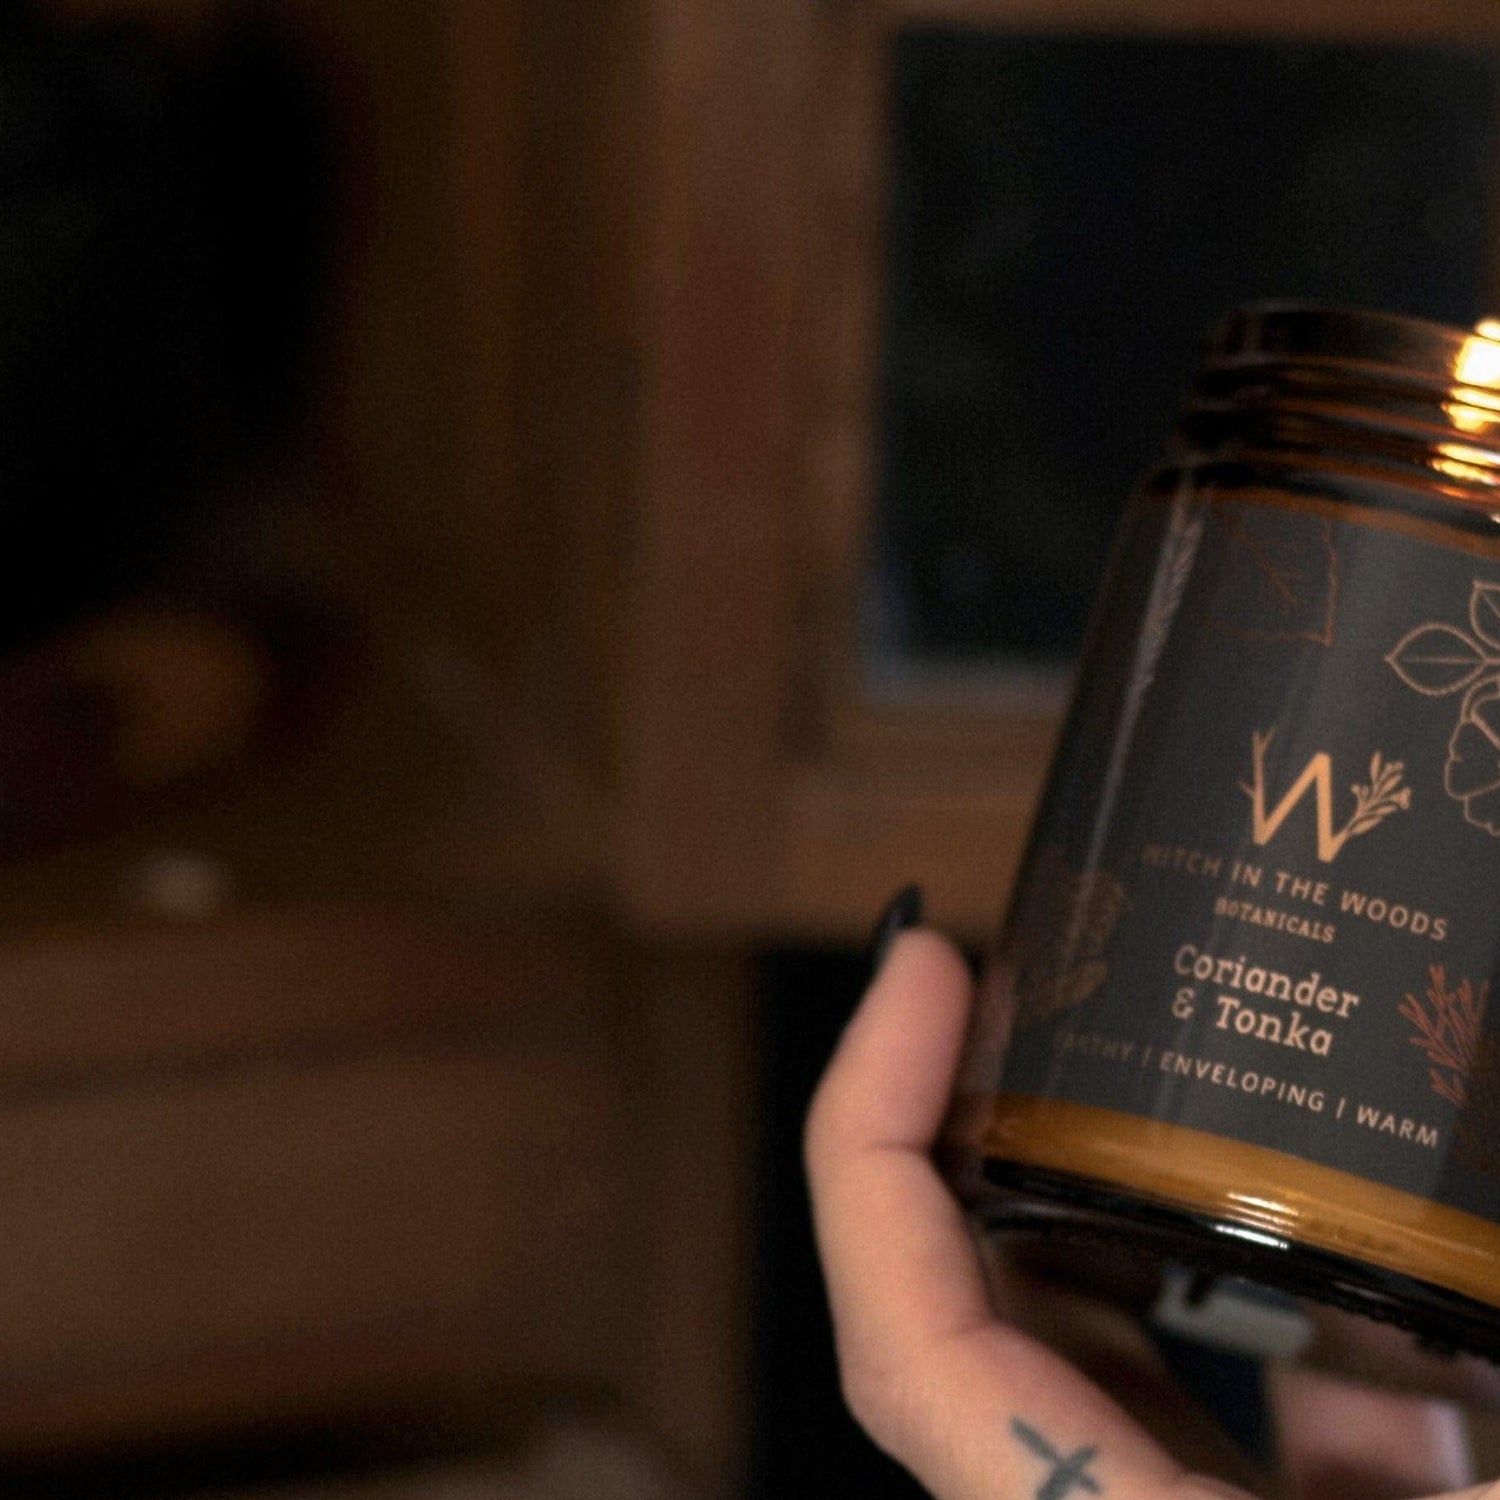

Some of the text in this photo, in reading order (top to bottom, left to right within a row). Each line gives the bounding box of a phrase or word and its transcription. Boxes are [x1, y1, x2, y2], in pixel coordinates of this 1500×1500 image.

[1214, 896, 1336, 943] BOTANICALS
[1230, 860, 1264, 887] IN
[1275, 871, 1328, 906] THE
[1341, 890, 1450, 941] WOODS
[1173, 944, 1360, 1018] Coriander
[1171, 988, 1334, 1056] & Tonka
[1159, 1051, 1324, 1112] ENVELOPING
[1356, 1106, 1439, 1147] WARM
